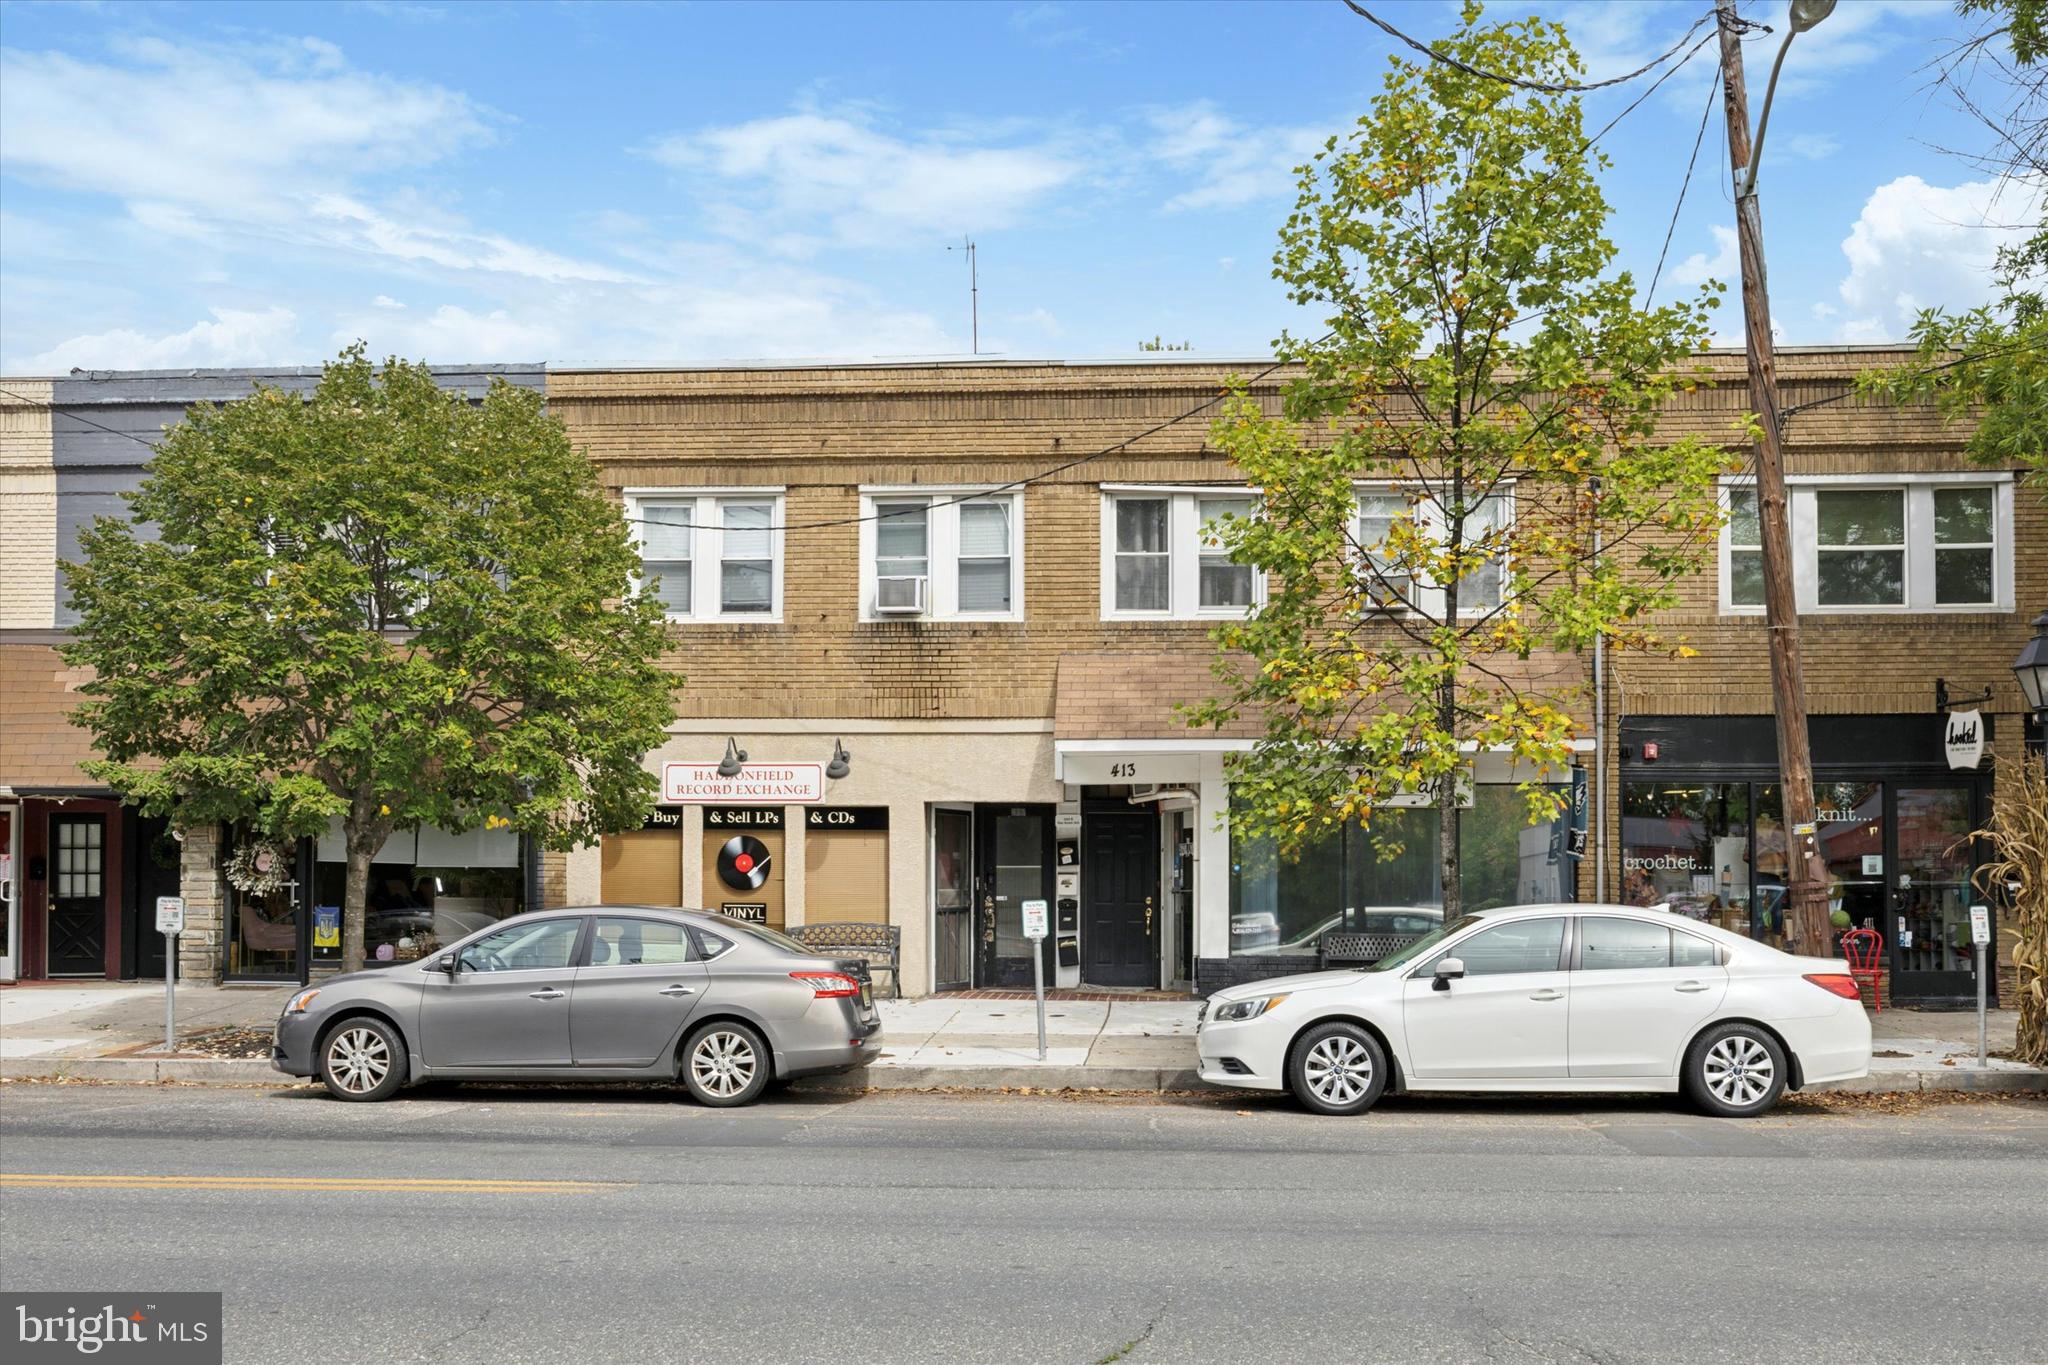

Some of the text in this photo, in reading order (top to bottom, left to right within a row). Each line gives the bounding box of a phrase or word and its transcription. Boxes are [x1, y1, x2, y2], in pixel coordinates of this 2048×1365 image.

[1110, 763, 1136, 777] 413
[677, 784, 811, 795] RECORD EXCHANGE
[653, 811, 680, 826] Buy
[710, 811, 780, 824] & Sell LPs
[810, 811, 855, 824] & CDs
[1815, 806, 1872, 822] knit...
[723, 907, 765, 919] VINYL
